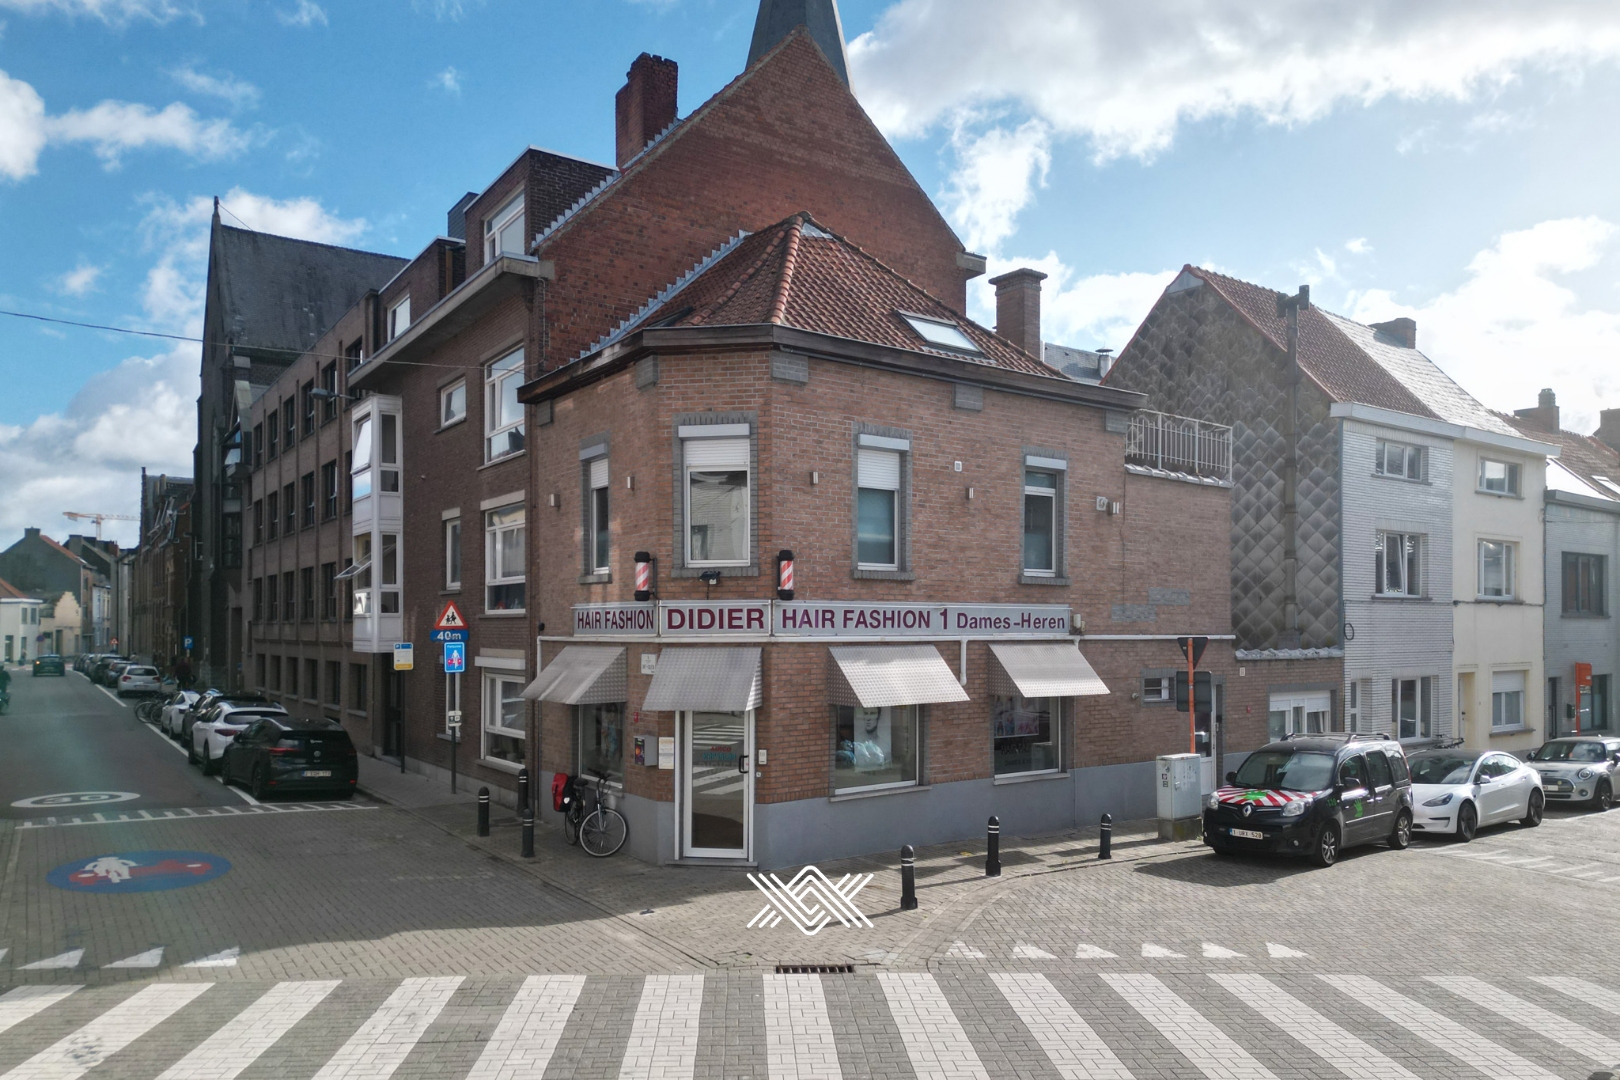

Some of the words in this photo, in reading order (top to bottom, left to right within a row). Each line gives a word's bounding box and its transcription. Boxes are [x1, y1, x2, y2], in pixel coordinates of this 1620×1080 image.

[577, 611, 602, 629] HAIR
[604, 609, 654, 629] FASHION
[667, 608, 764, 629] DIDIER
[782, 609, 836, 628] HAIR
[842, 609, 931, 629] FASHION
[939, 608, 948, 629] 1
[437, 631, 462, 640] 40m
